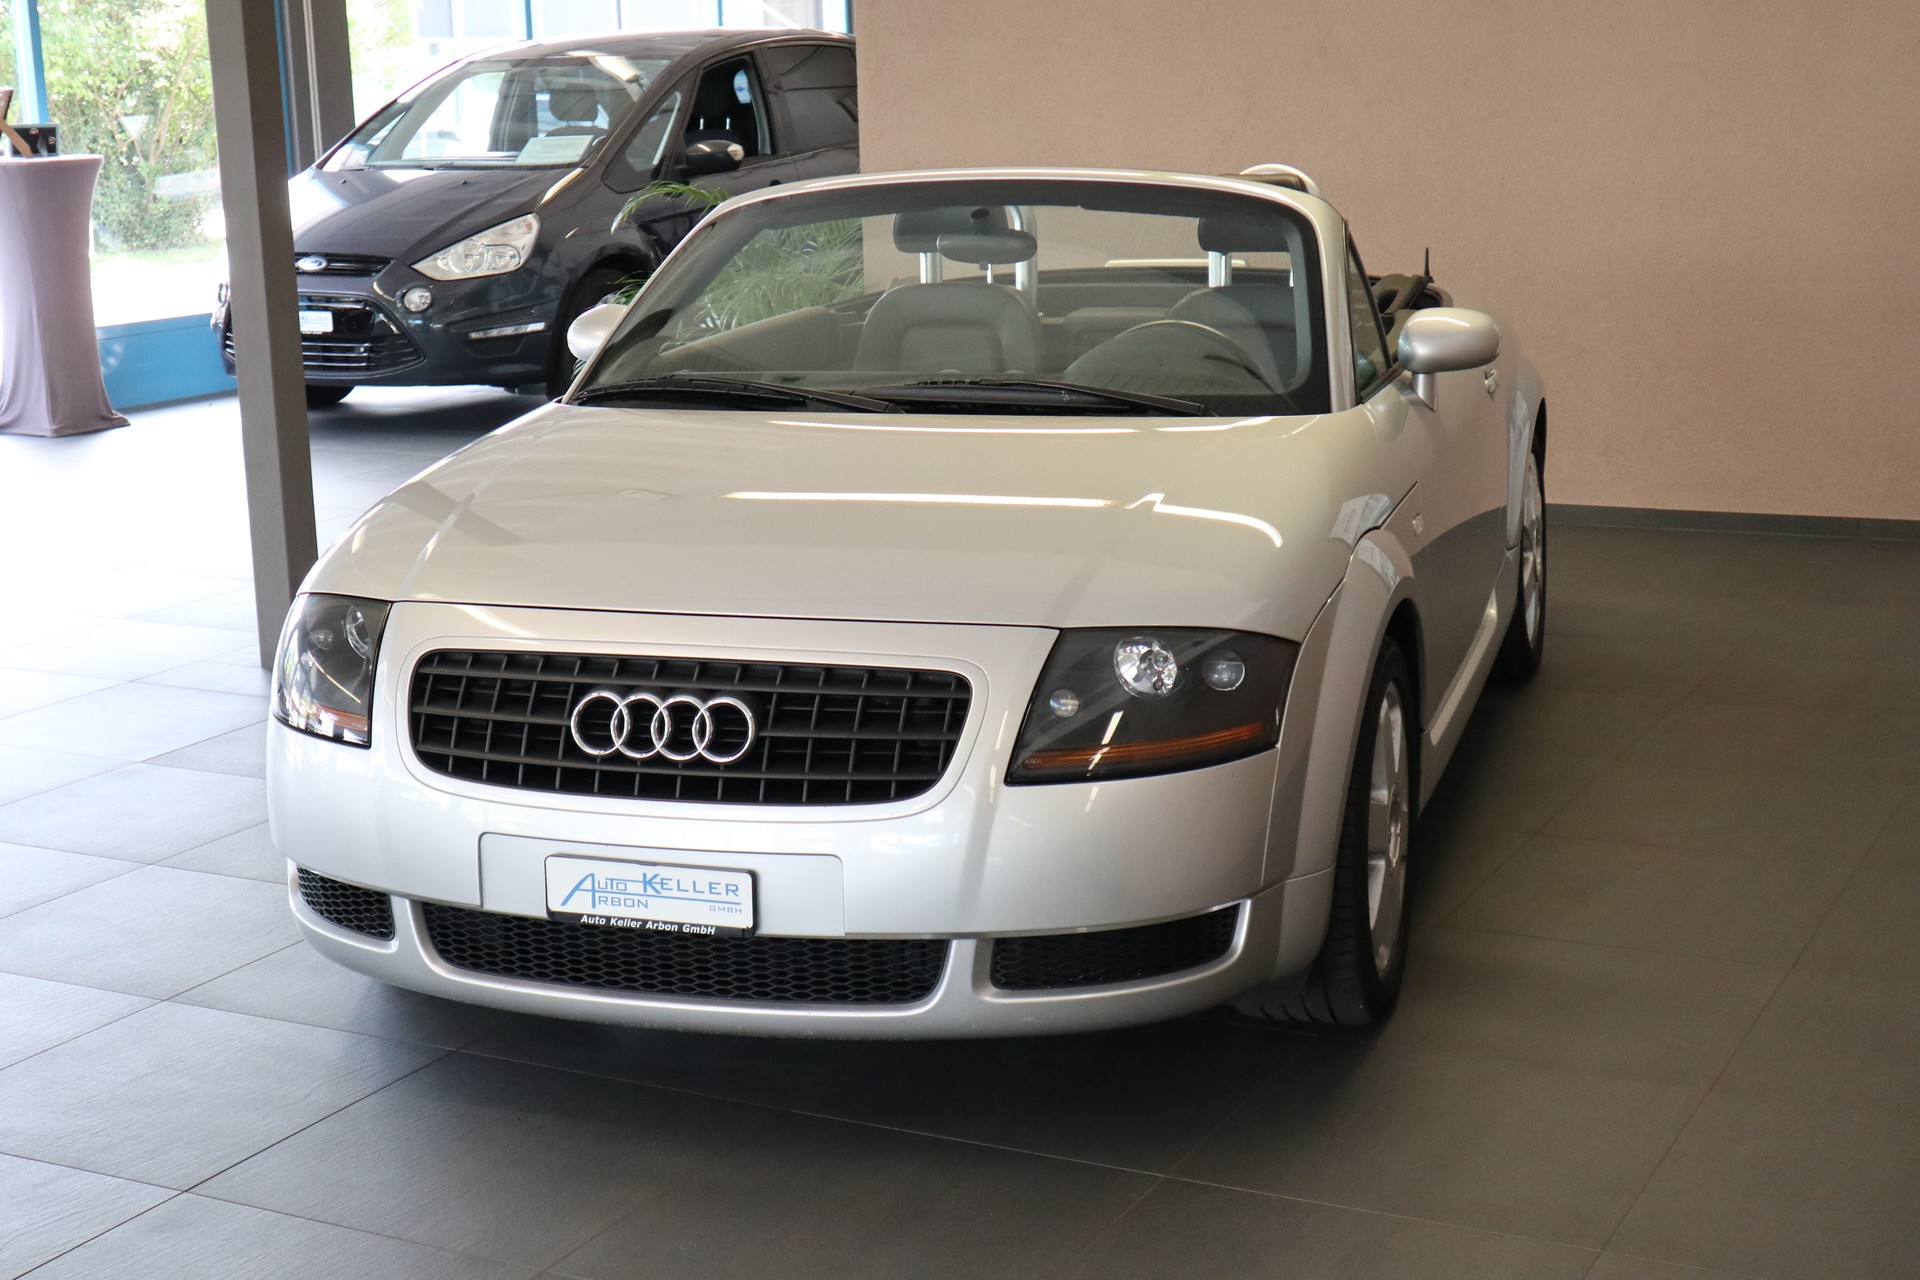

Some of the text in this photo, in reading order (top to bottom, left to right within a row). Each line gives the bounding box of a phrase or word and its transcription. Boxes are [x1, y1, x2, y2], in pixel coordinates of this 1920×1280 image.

[642, 873, 740, 897] KELLER
[708, 905, 743, 914] GMBH
[580, 914, 716, 936] Auto Keller Arbon GmbH
